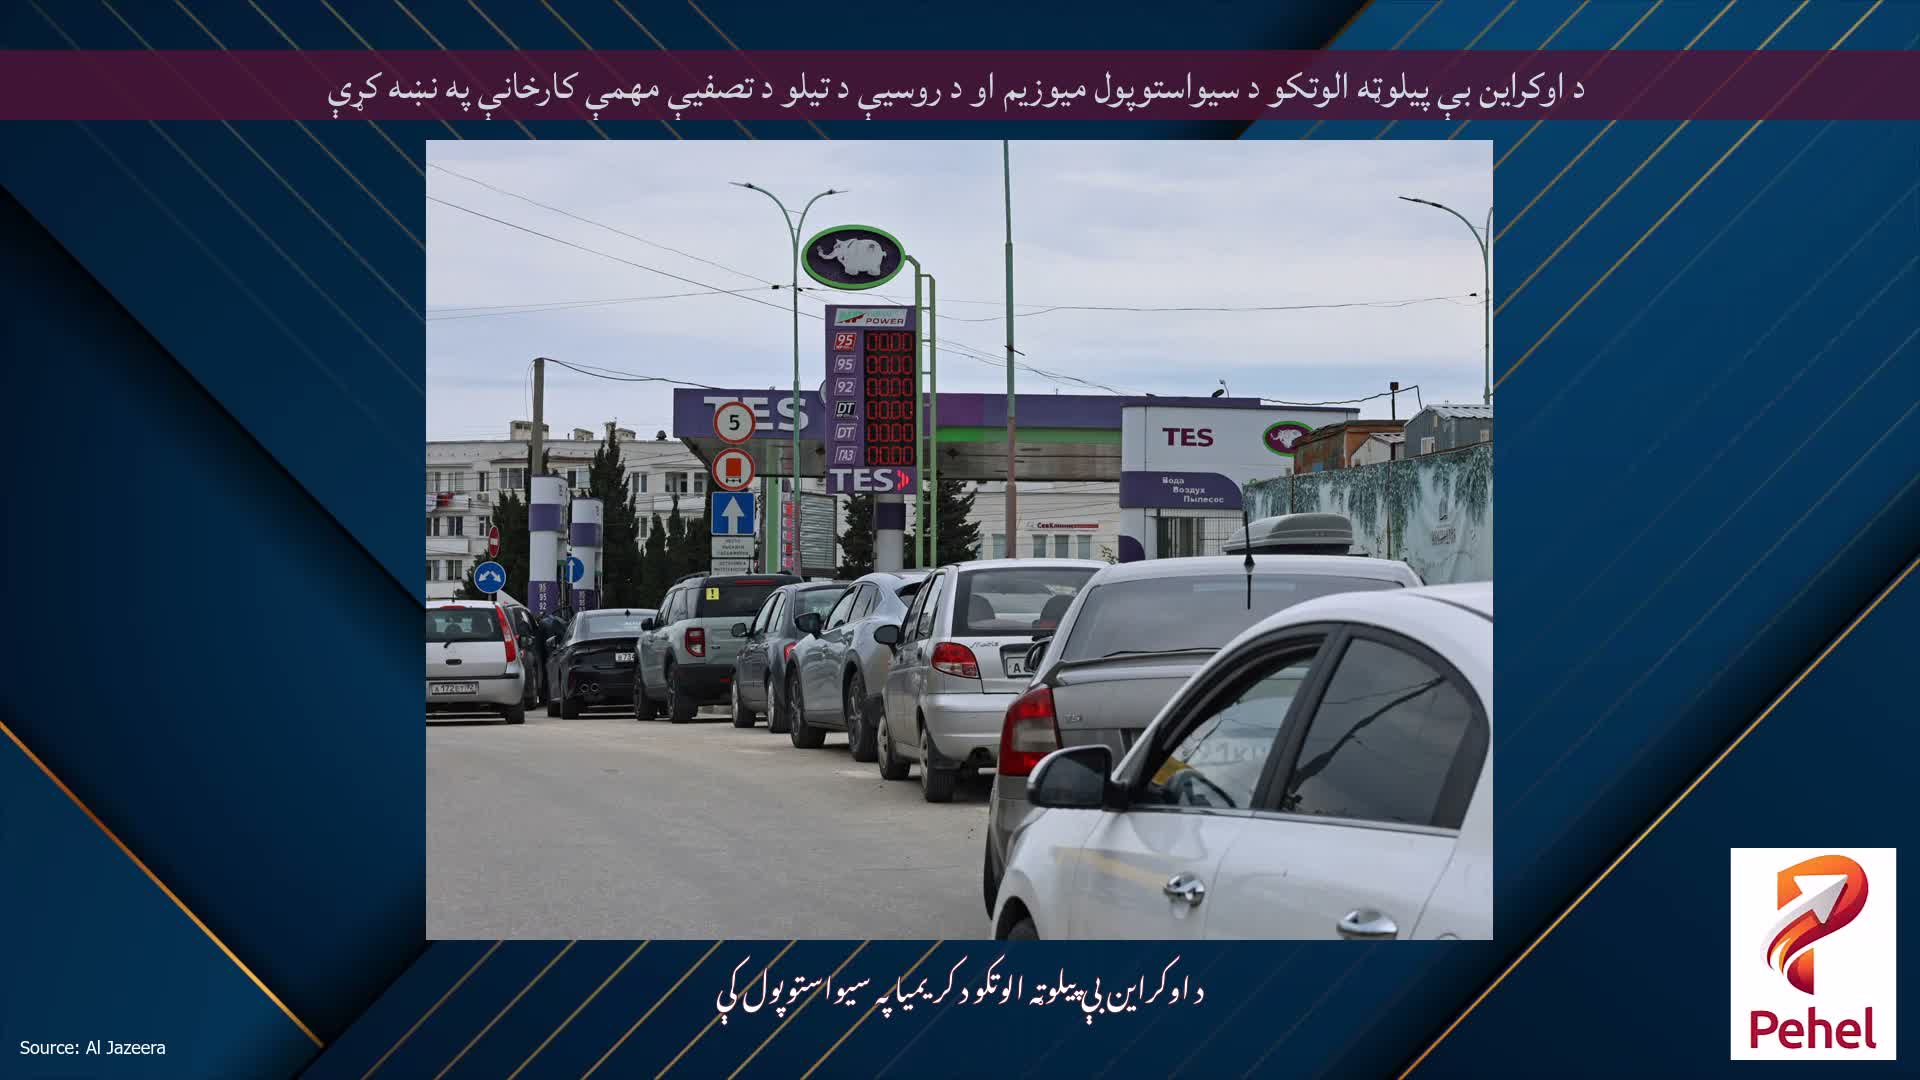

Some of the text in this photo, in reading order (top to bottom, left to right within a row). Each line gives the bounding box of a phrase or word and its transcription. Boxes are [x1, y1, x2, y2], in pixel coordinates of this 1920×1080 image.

[865, 317, 904, 326] POWER
[837, 334, 853, 346] 95
[837, 358, 853, 370] 95
[838, 381, 854, 393] 92
[838, 402, 855, 414] DT
[729, 414, 740, 430] 5
[837, 427, 855, 438] DT
[1162, 427, 1214, 447] TES
[839, 449, 854, 461] ГАЗ
[829, 468, 894, 491] TES
[1162, 477, 1184, 485] Вода
[1173, 486, 1205, 495] Воздух
[1183, 495, 1224, 503] Пылесос
